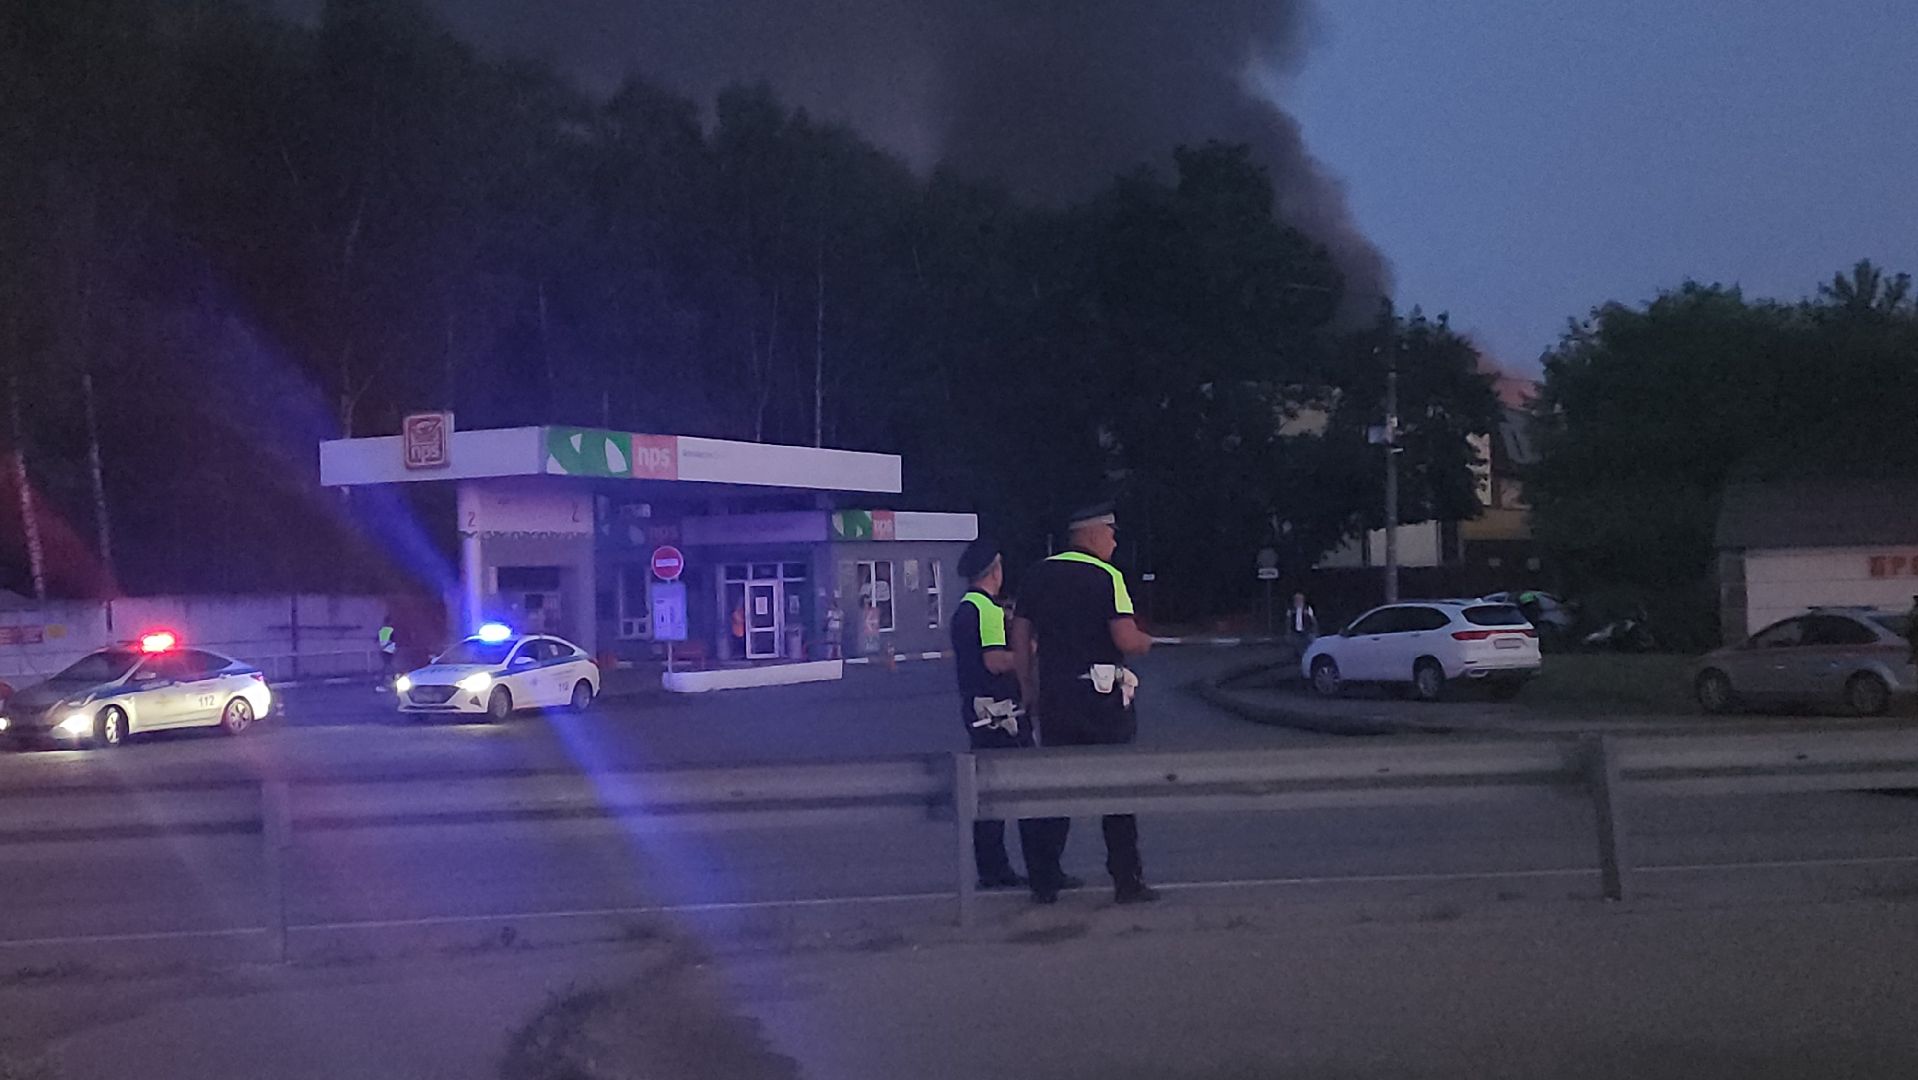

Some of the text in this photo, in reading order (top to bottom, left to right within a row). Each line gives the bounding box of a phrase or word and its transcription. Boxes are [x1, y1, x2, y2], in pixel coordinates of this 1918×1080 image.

[410, 445, 440, 465] nps
[638, 447, 671, 471] nps
[468, 511, 476, 527] 2
[199, 695, 215, 707] 112
